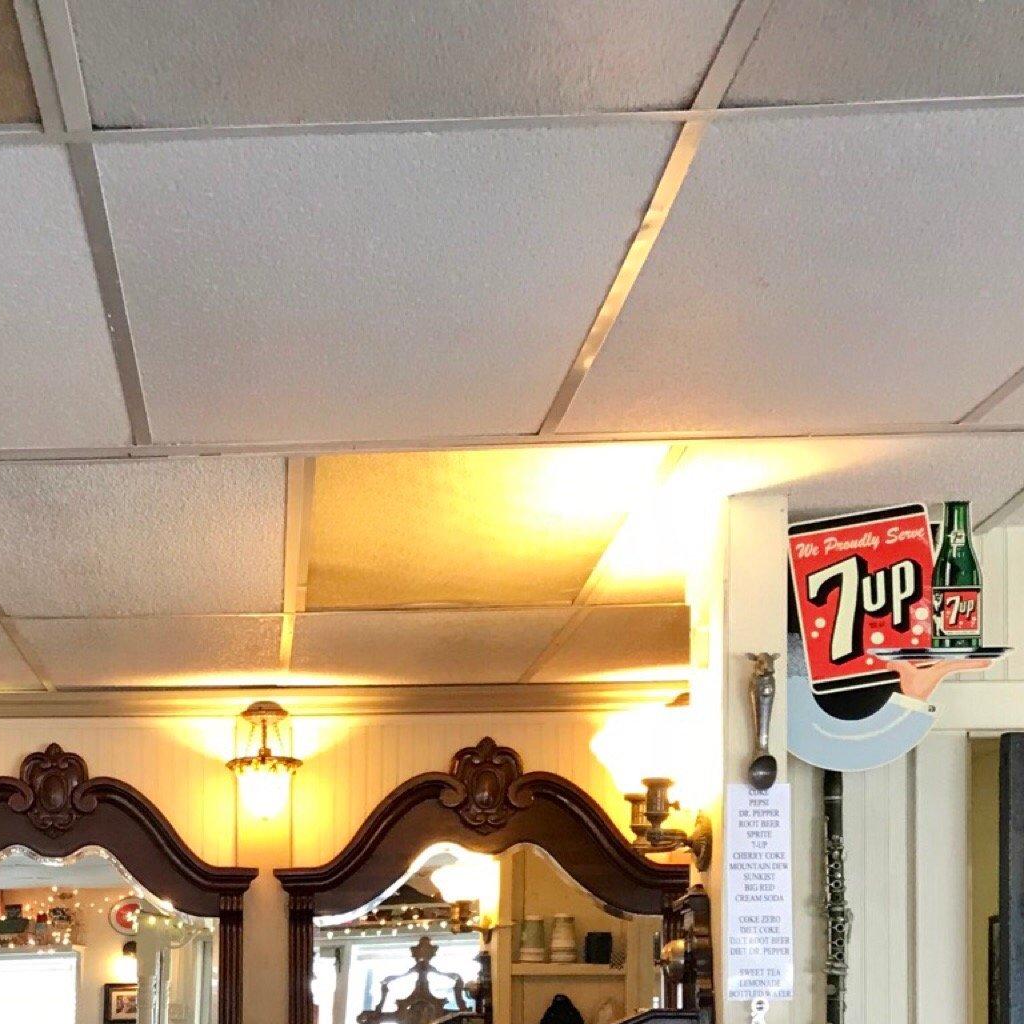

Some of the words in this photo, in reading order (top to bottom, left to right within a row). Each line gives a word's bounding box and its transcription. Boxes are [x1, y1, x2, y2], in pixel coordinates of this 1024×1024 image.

[796, 542, 819, 558] We
[823, 531, 880, 555] Proudly
[885, 526, 924, 545] Serve
[752, 810, 780, 818] PEPPER
[738, 820, 758, 828] ROOT
[760, 820, 780, 828] BEER
[746, 830, 772, 838] SPRITE
[732, 852, 763, 860] CHERRY
[765, 852, 786, 860] COKE
[735, 894, 762, 902] CREAM
[763, 894, 784, 902] SODA
[739, 968, 764, 976] SWEET
[767, 968, 781, 976] TEA
